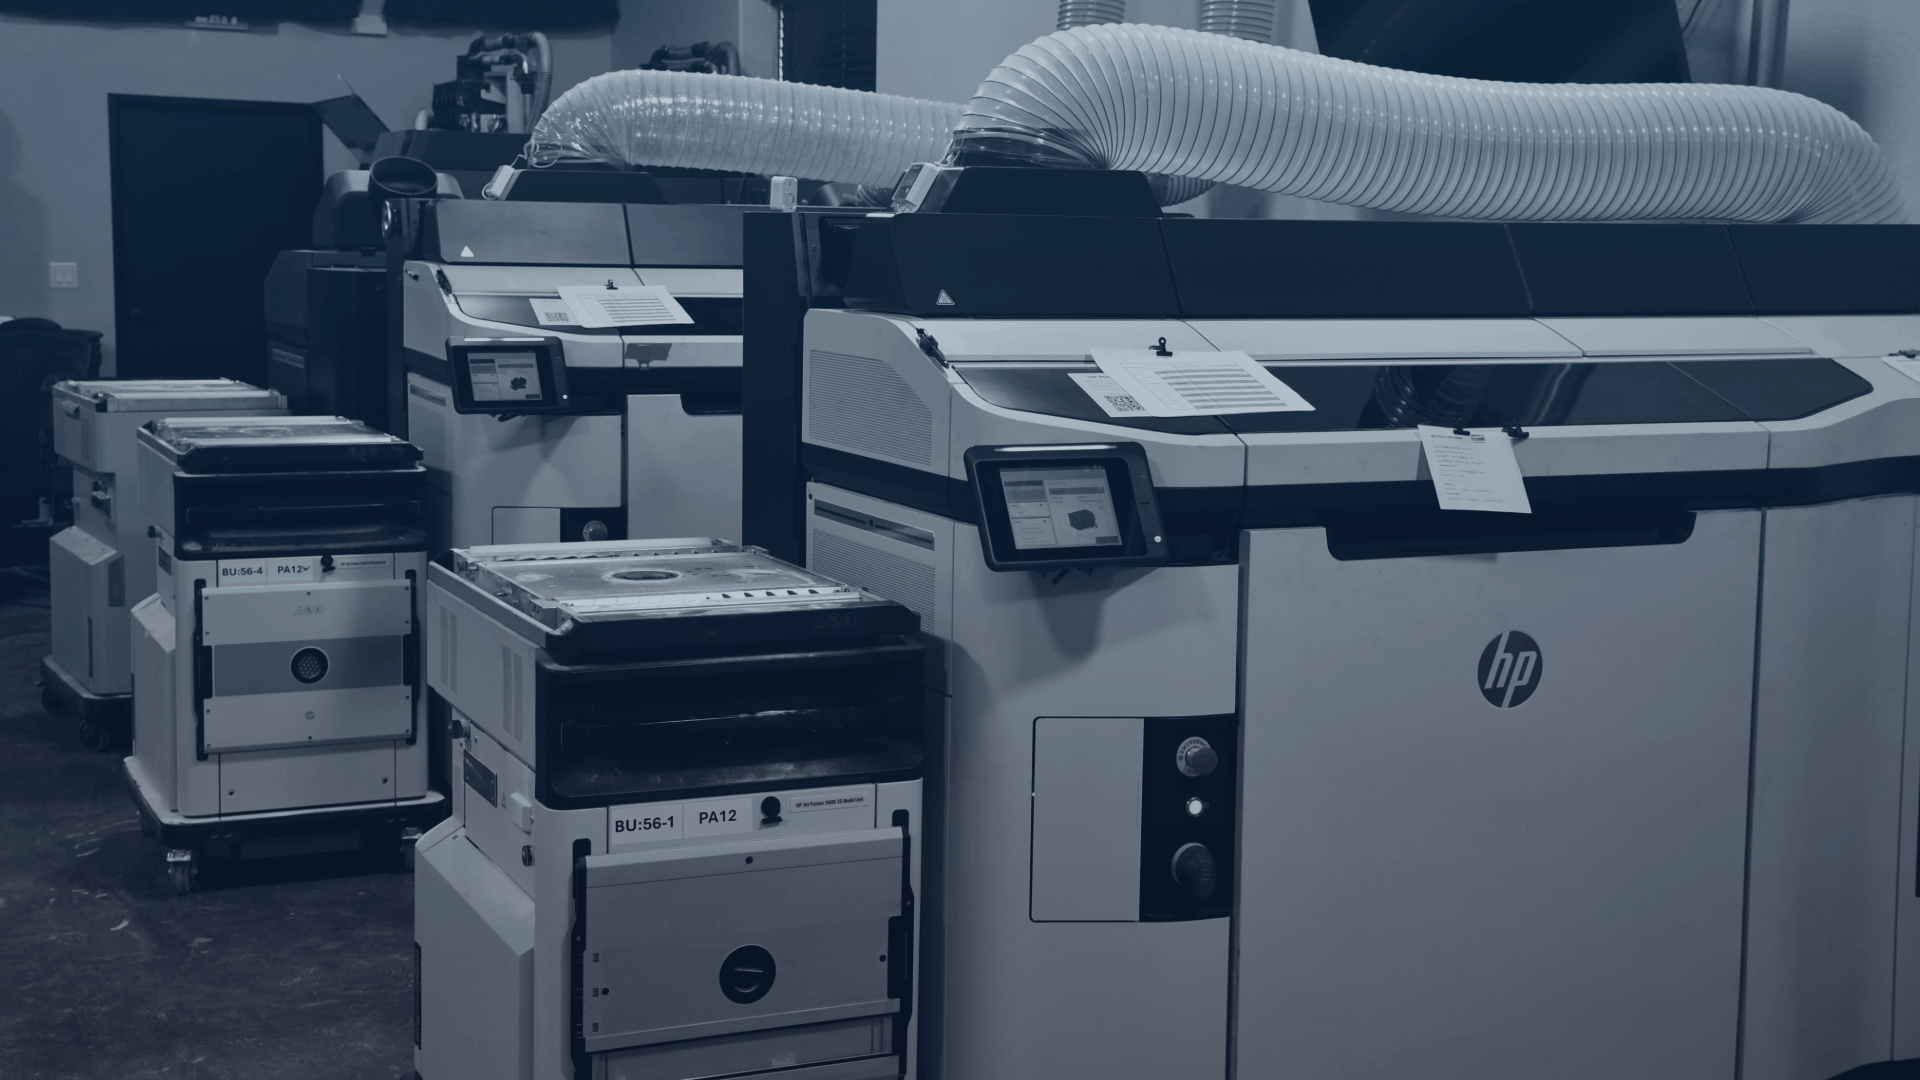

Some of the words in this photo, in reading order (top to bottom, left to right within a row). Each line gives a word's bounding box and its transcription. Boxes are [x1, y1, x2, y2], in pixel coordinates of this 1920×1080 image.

[222, 566, 263, 576] BU:56-4
[1483, 630, 1539, 708] hp
[1180, 739, 1208, 754] EMERGENC
[615, 815, 674, 832] BU:56-1
[698, 809, 738, 824] PA12
